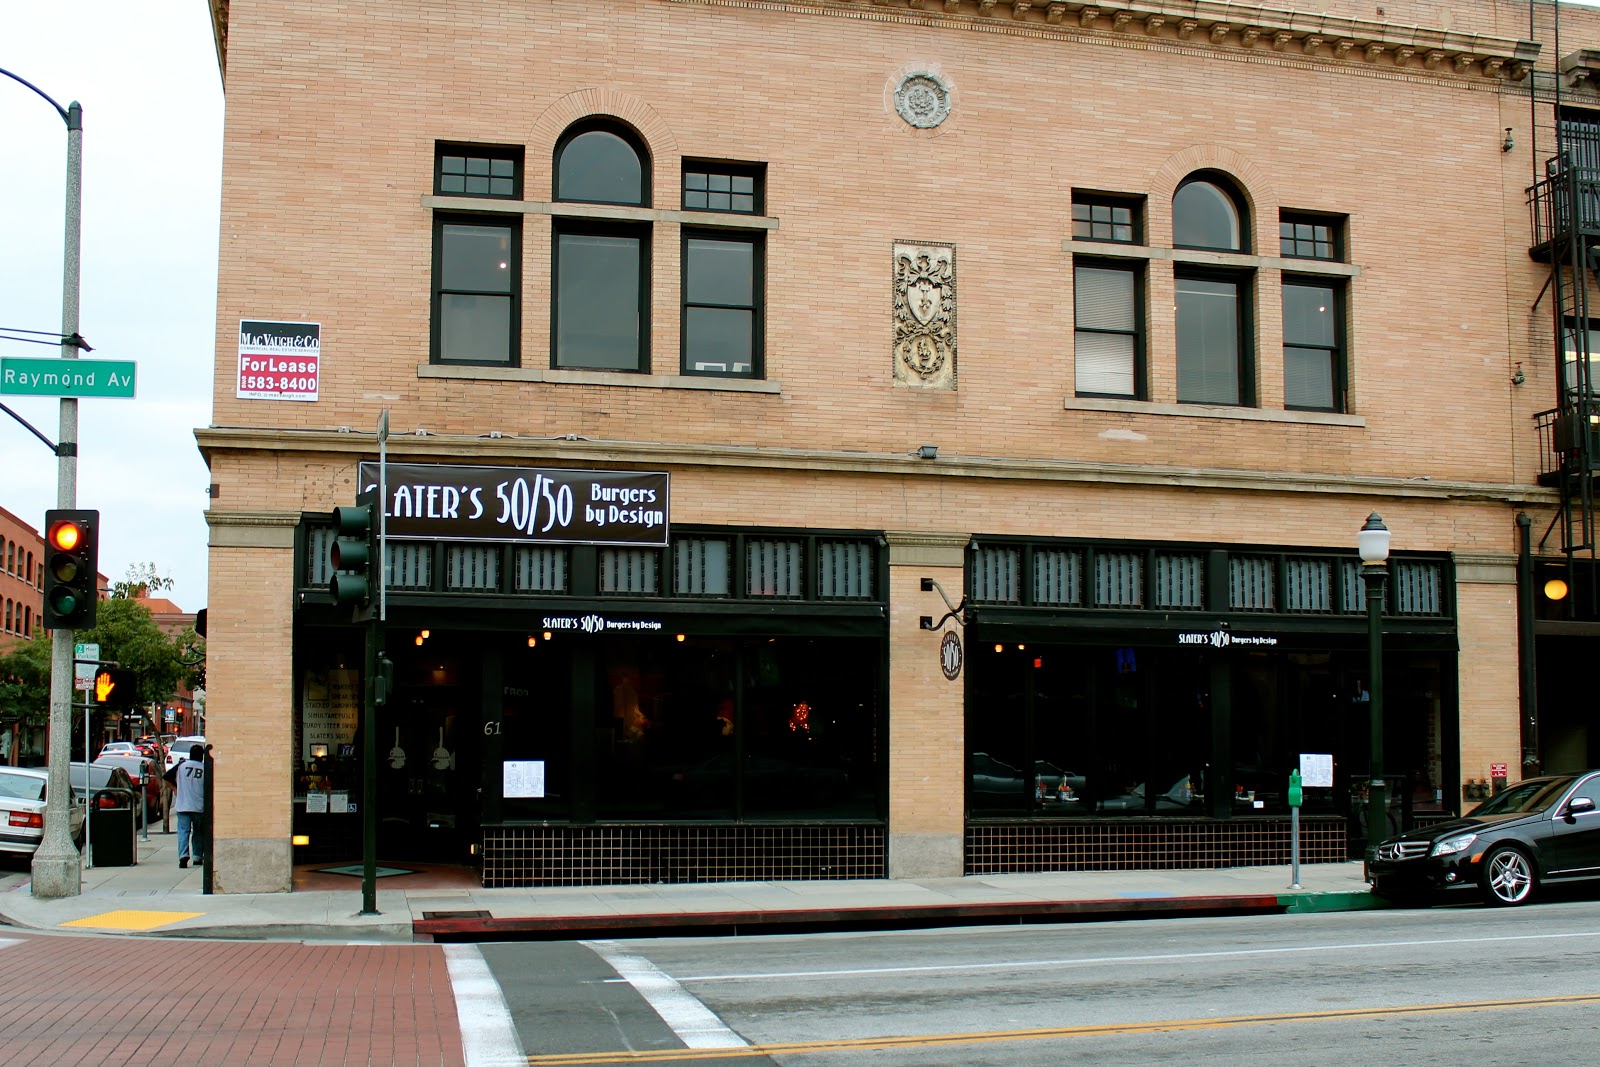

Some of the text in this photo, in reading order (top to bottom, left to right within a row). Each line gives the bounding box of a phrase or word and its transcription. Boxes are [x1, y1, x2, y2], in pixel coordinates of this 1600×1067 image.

[242, 358, 316, 373] For Lease
[4, 369, 131, 388] Raymond Av
[248, 376, 316, 390] 583-8400
[592, 483, 656, 506] Burgers
[365, 474, 573, 536] LATER'S 50/50
[586, 505, 663, 528] by Design
[542, 614, 662, 633] SLATER'S 50/50 Burgers by Design
[1178, 634, 1208, 644] SLATER'S
[1210, 630, 1230, 648] 50/50
[1231, 636, 1252, 644] Burgers
[1260, 637, 1277, 646] Design
[484, 721, 502, 735] 61
